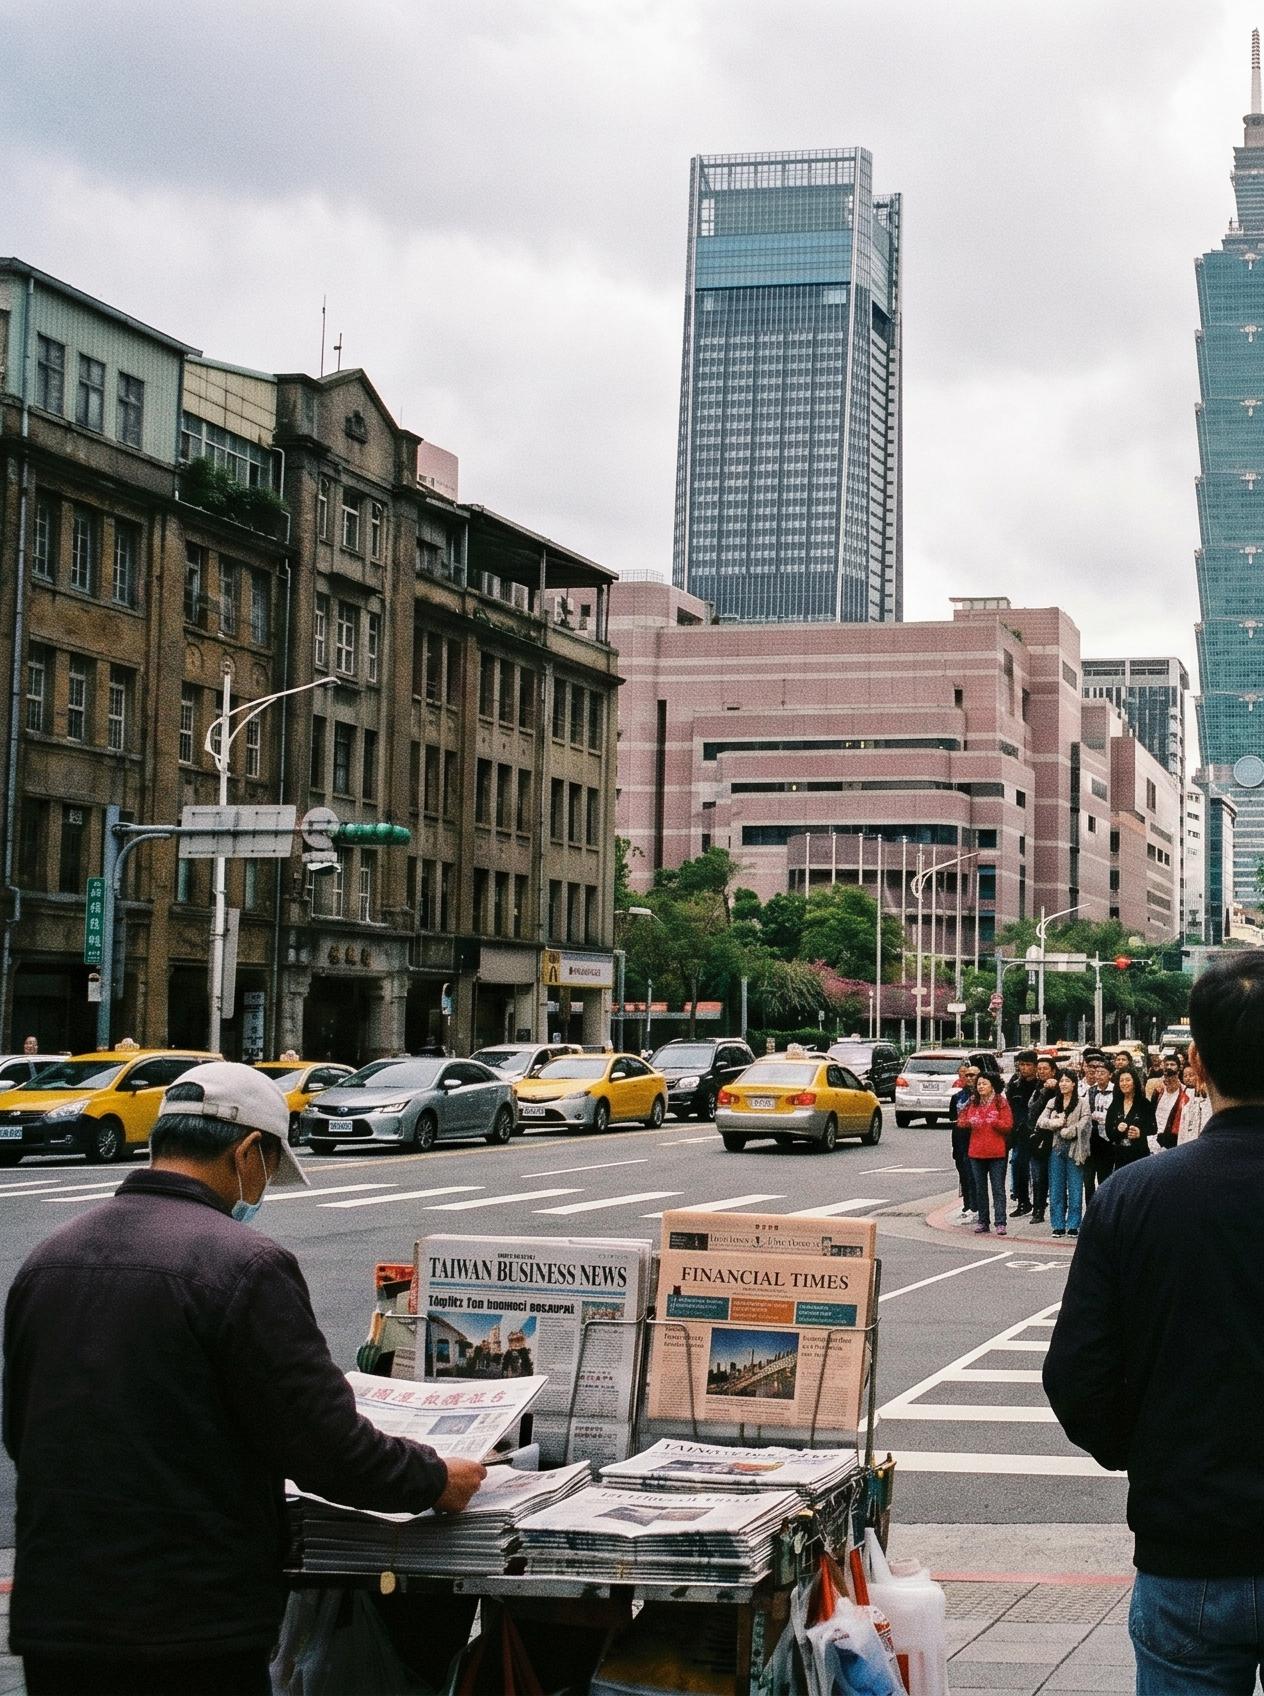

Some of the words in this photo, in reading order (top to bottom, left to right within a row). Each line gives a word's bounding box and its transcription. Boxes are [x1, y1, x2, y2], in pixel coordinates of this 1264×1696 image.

[429, 1257, 493, 1281] TAIWAN
[497, 1260, 576, 1284] BUSINESS
[580, 1264, 627, 1288] NEWS
[681, 1266, 786, 1287] FINANCIAL
[790, 1272, 849, 1290] TIMES
